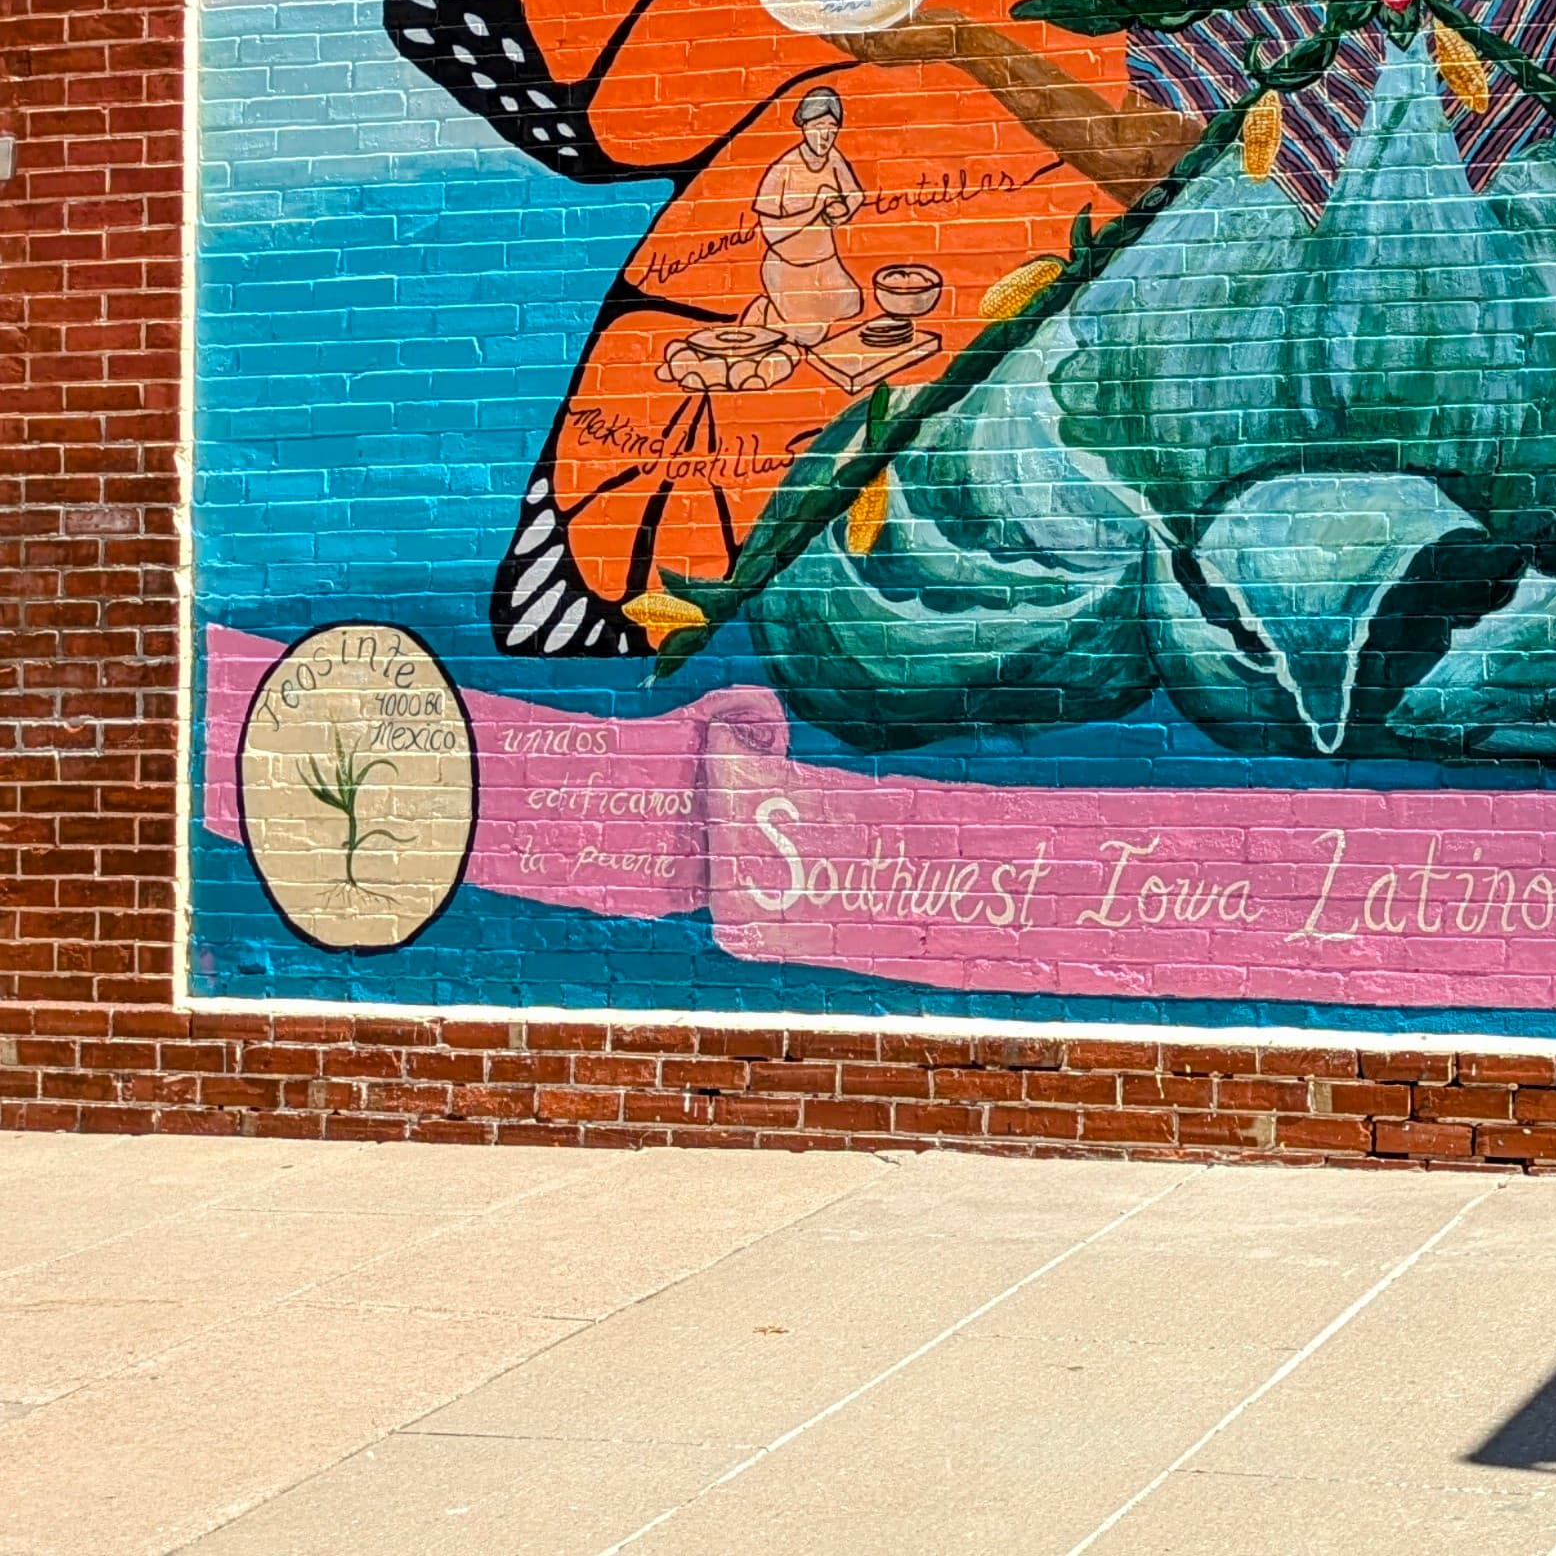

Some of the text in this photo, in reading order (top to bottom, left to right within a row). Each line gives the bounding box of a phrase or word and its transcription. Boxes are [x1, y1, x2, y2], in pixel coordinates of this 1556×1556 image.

[638, 212, 760, 287] Haciendo
[370, 721, 456, 752] Mexico
[502, 724, 609, 755] unidos
[742, 796, 1052, 929] Southwest
[1077, 834, 1266, 927] Iowa
